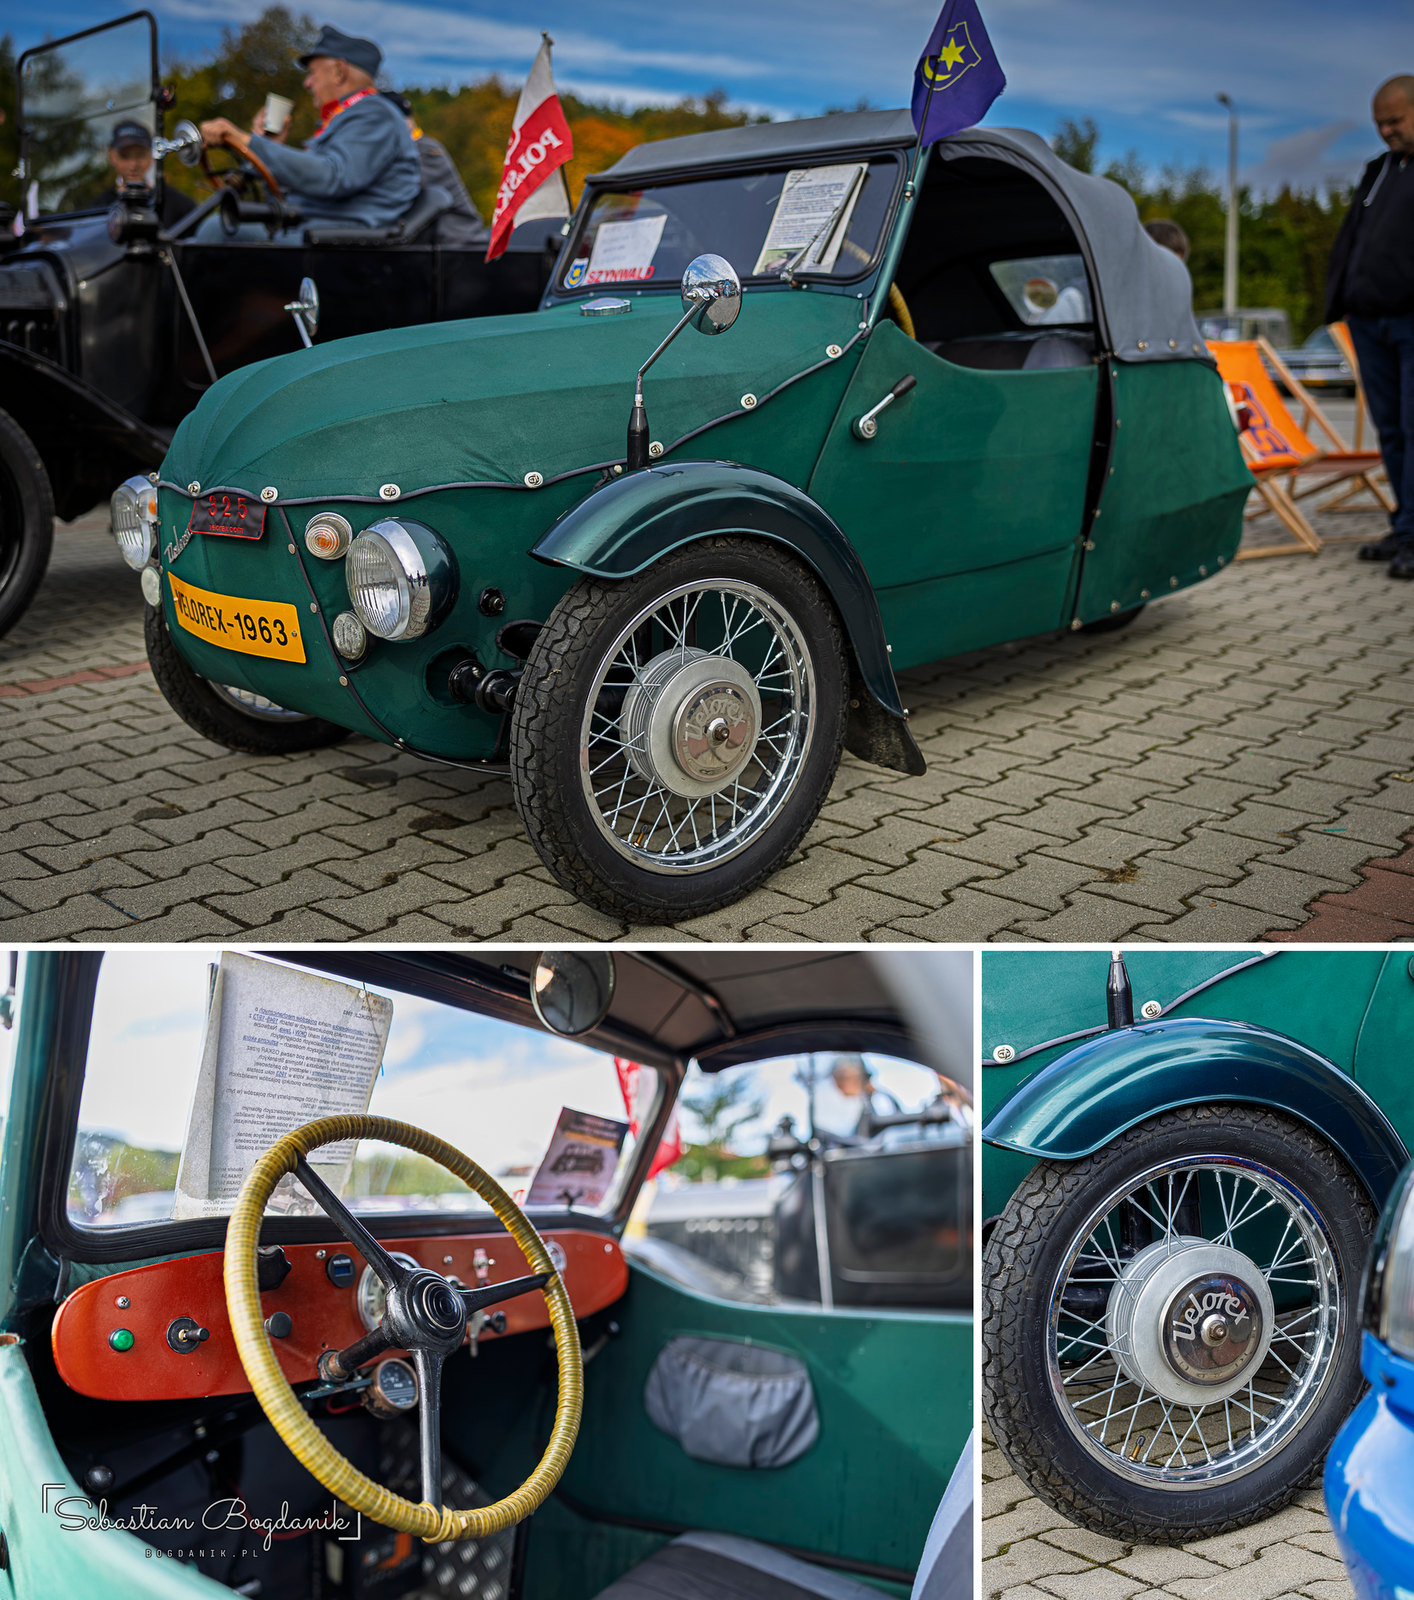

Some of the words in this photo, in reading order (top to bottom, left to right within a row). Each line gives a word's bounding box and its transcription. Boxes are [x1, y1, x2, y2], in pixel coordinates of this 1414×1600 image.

[587, 265, 655, 284] SZYNWALD
[207, 495, 248, 519] 325
[174, 589, 288, 646] VELOREX-1963
[1172, 1292, 1250, 1342] Velorex
